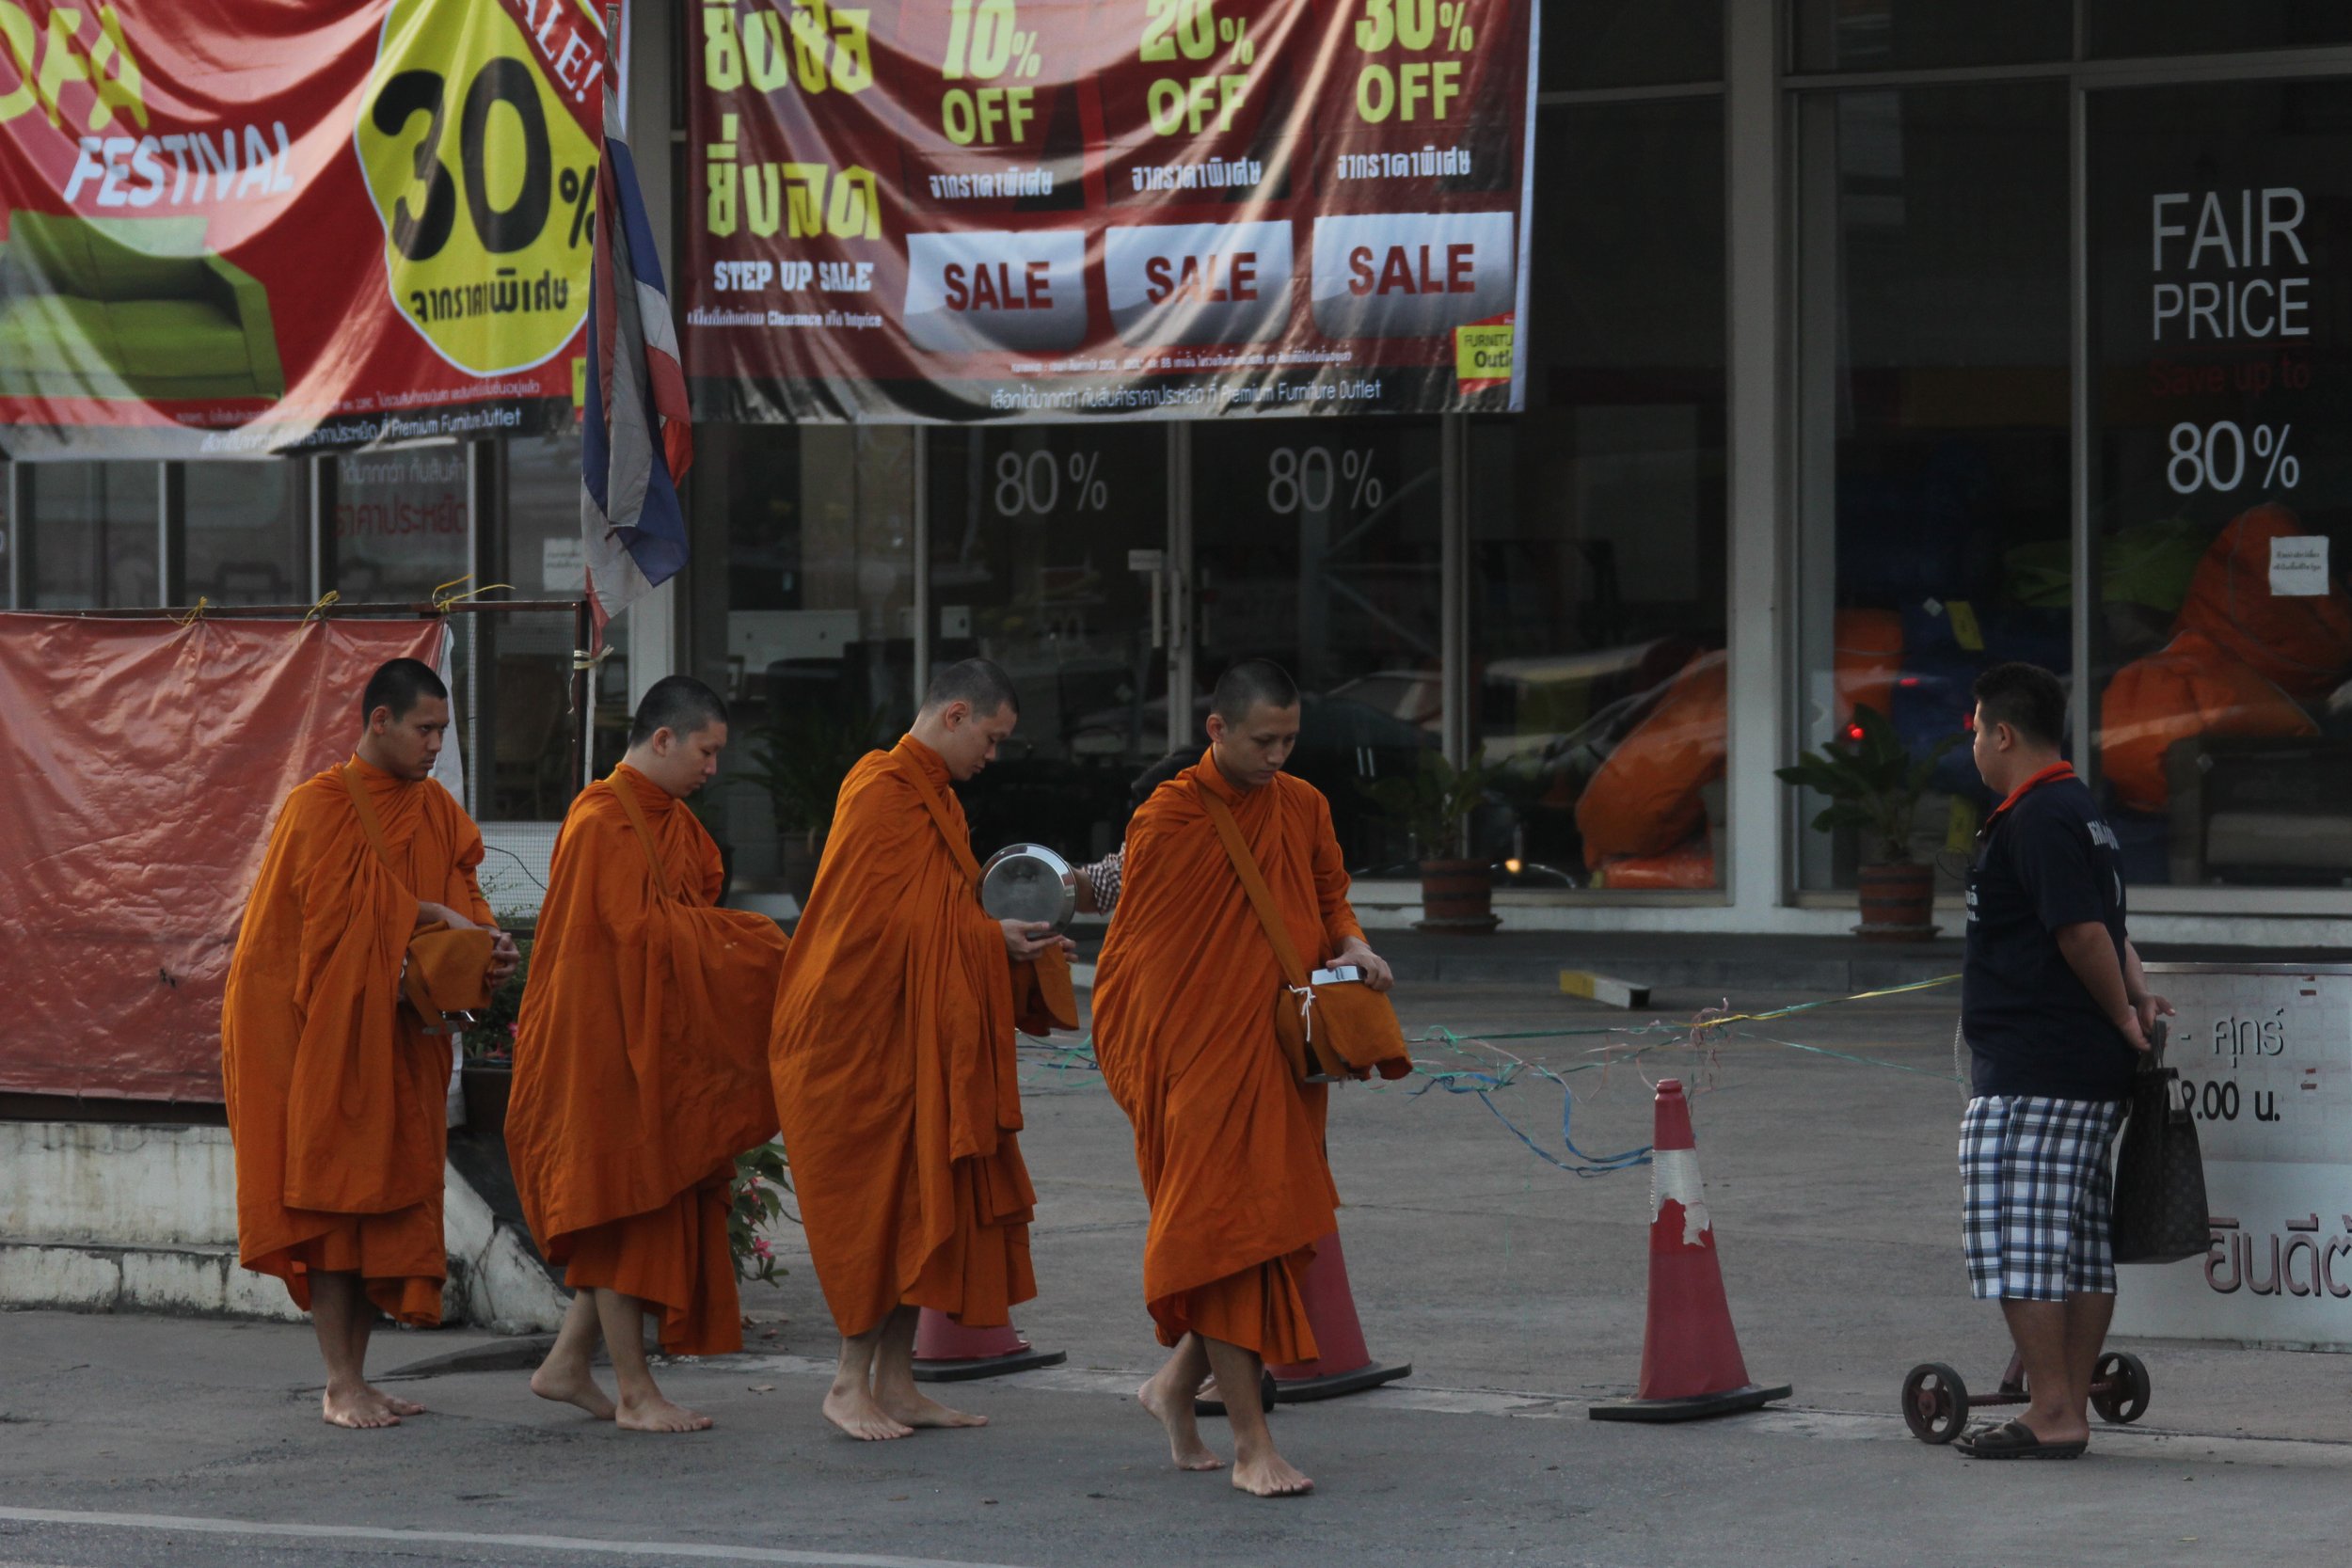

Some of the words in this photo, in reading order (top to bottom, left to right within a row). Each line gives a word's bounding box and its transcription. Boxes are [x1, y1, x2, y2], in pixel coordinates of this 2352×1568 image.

[942, 0, 1041, 80] 10%
[1139, 0, 1254, 65] 20%
[1356, 0, 1474, 53] 30%
[942, 87, 1035, 145] OFF
[1147, 73, 1249, 136] OFF
[1357, 60, 1462, 124] OFF
[64, 121, 294, 206] FESTIVAL
[372, 56, 597, 261] 30%
[930, 166, 1053, 199] จากราคาพิเศษ
[1132, 157, 1262, 191] จากราคาพิเศษ
[1337, 146, 1470, 180] จากราคาพิเศษ
[2153, 187, 2310, 272] FAIR
[410, 267, 568, 323] จากราคาพิเศษ
[714, 261, 772, 291] STEP
[780, 262, 812, 291] UP
[820, 262, 873, 293] SALE
[944, 261, 1054, 311] SALE
[1145, 251, 1257, 306] SALE
[1348, 243, 1475, 296] SALE
[2153, 277, 2310, 341] PRICE
[1222, 381, 1275, 403] Premium
[1278, 381, 1335, 402] Furniture
[1339, 378, 1381, 399] Outlet
[2149, 357, 2225, 397] Save
[2234, 361, 2273, 400] up
[2281, 353, 2312, 390] to
[391, 414, 438, 437] Premium
[994, 450, 1108, 517] 80%
[1267, 446, 1383, 515] 80%
[2168, 420, 2299, 494] 80%
[2214, 1007, 2284, 1069] ศุกร์
[2254, 1091, 2280, 1121] น.
